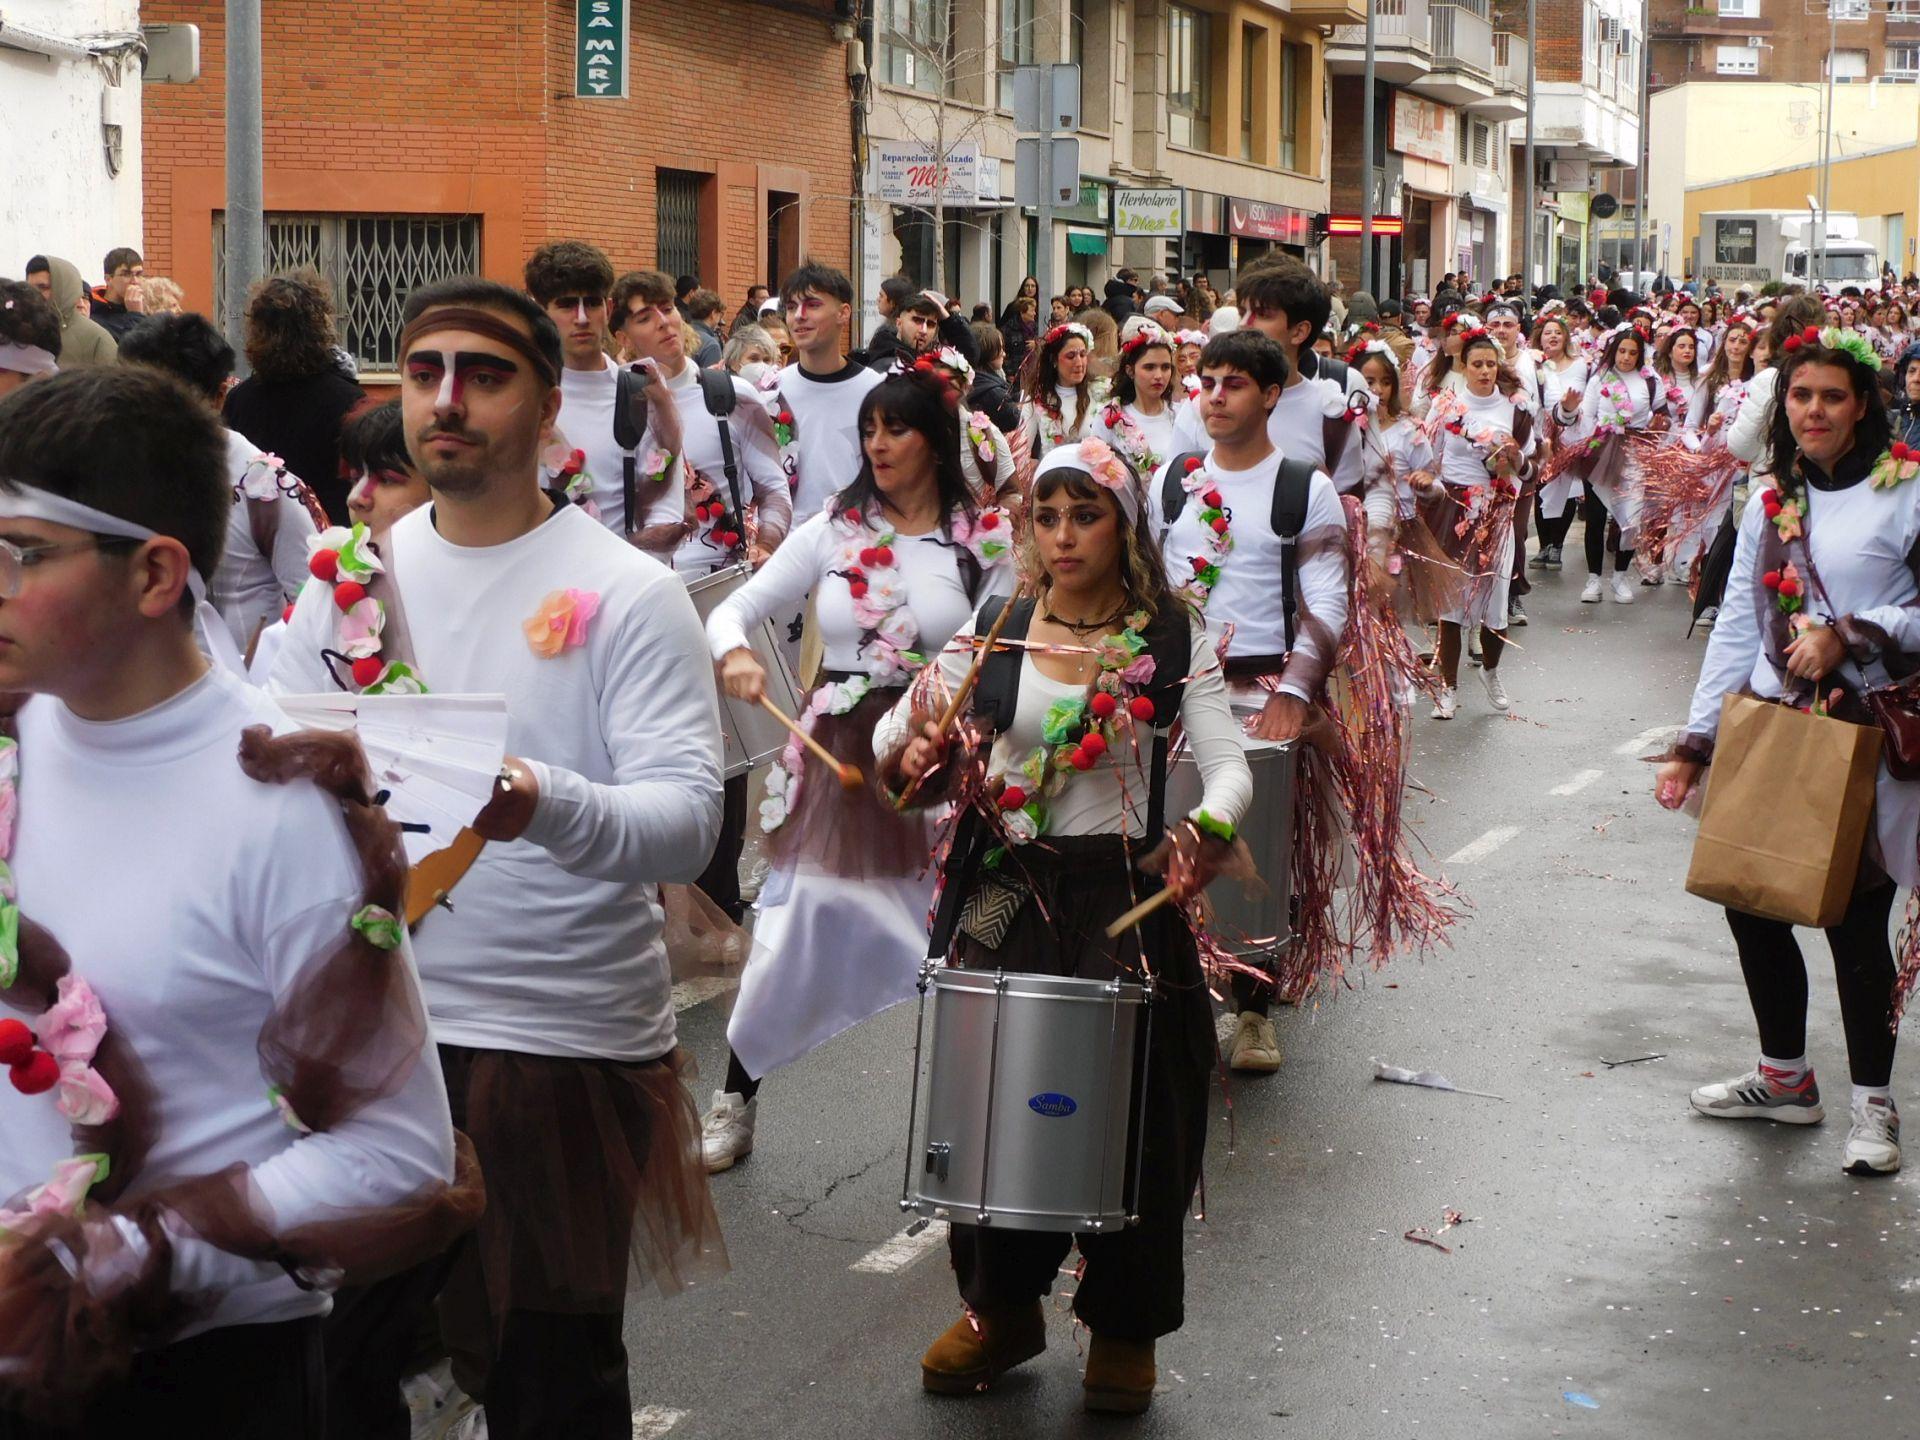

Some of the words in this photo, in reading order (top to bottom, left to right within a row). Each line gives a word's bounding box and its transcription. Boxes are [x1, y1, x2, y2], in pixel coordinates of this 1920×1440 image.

[585, 39, 615, 94] MARY
[882, 153, 928, 164] Reparacion
[943, 155, 974, 163] alzado
[1119, 192, 1177, 208] Herbolario
[1032, 1095, 1071, 1112] Samba
